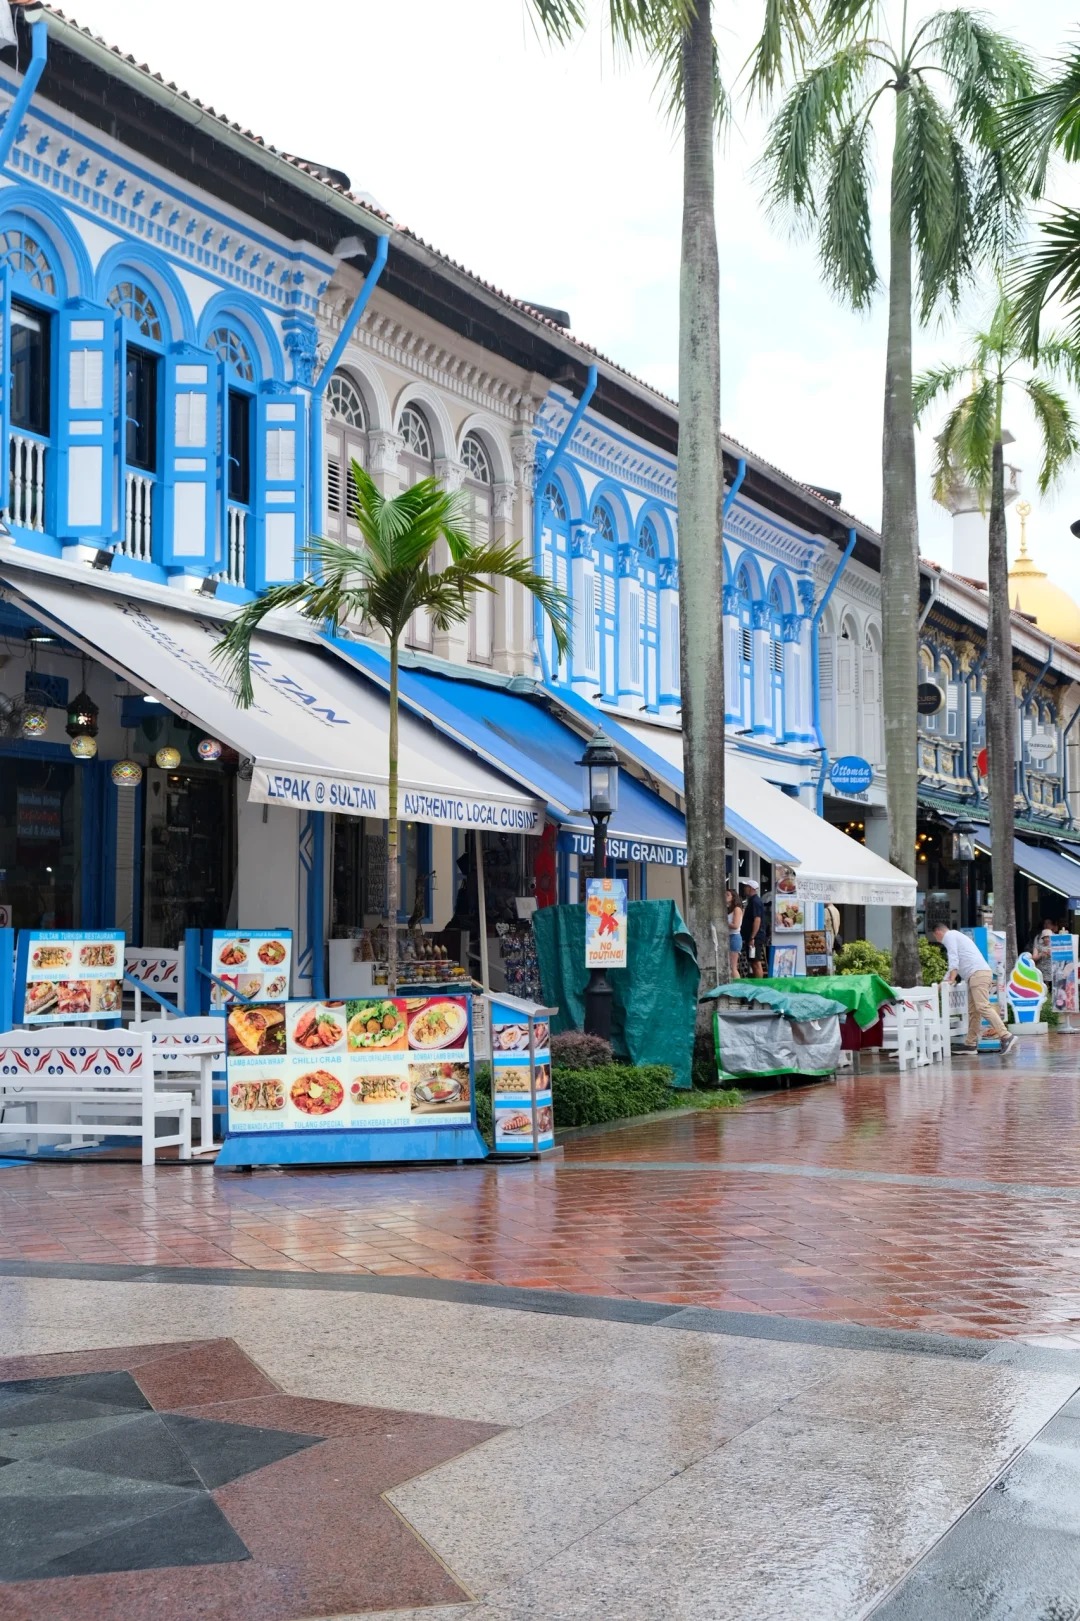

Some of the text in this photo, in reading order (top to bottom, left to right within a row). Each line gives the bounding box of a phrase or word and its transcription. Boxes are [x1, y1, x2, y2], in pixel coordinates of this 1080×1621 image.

[831, 762, 870, 776] Ottoman
[850, 776, 870, 784] DELIGHTS
[266, 774, 377, 810] LEPAK @ SULTAN
[404, 793, 464, 821] AUTHENTIC
[466, 803, 499, 826] LOCAL
[631, 843, 674, 864] GRAND
[38, 931, 117, 940] SULTAN TURKISH RESTAURANT
[601, 942, 612, 951] NO
[589, 950, 624, 961] TOUTING!
[229, 1057, 285, 1067] LAMB ADANA WRAP
[292, 1055, 342, 1065] CHILLI CRAB
[247, 1122, 263, 1130] MANDI
[263, 1121, 284, 1129] PLATTER
[319, 1120, 344, 1128] SPECIAL
[351, 1119, 367, 1127] MIXED
[386, 1117, 411, 1126] PLATTER
